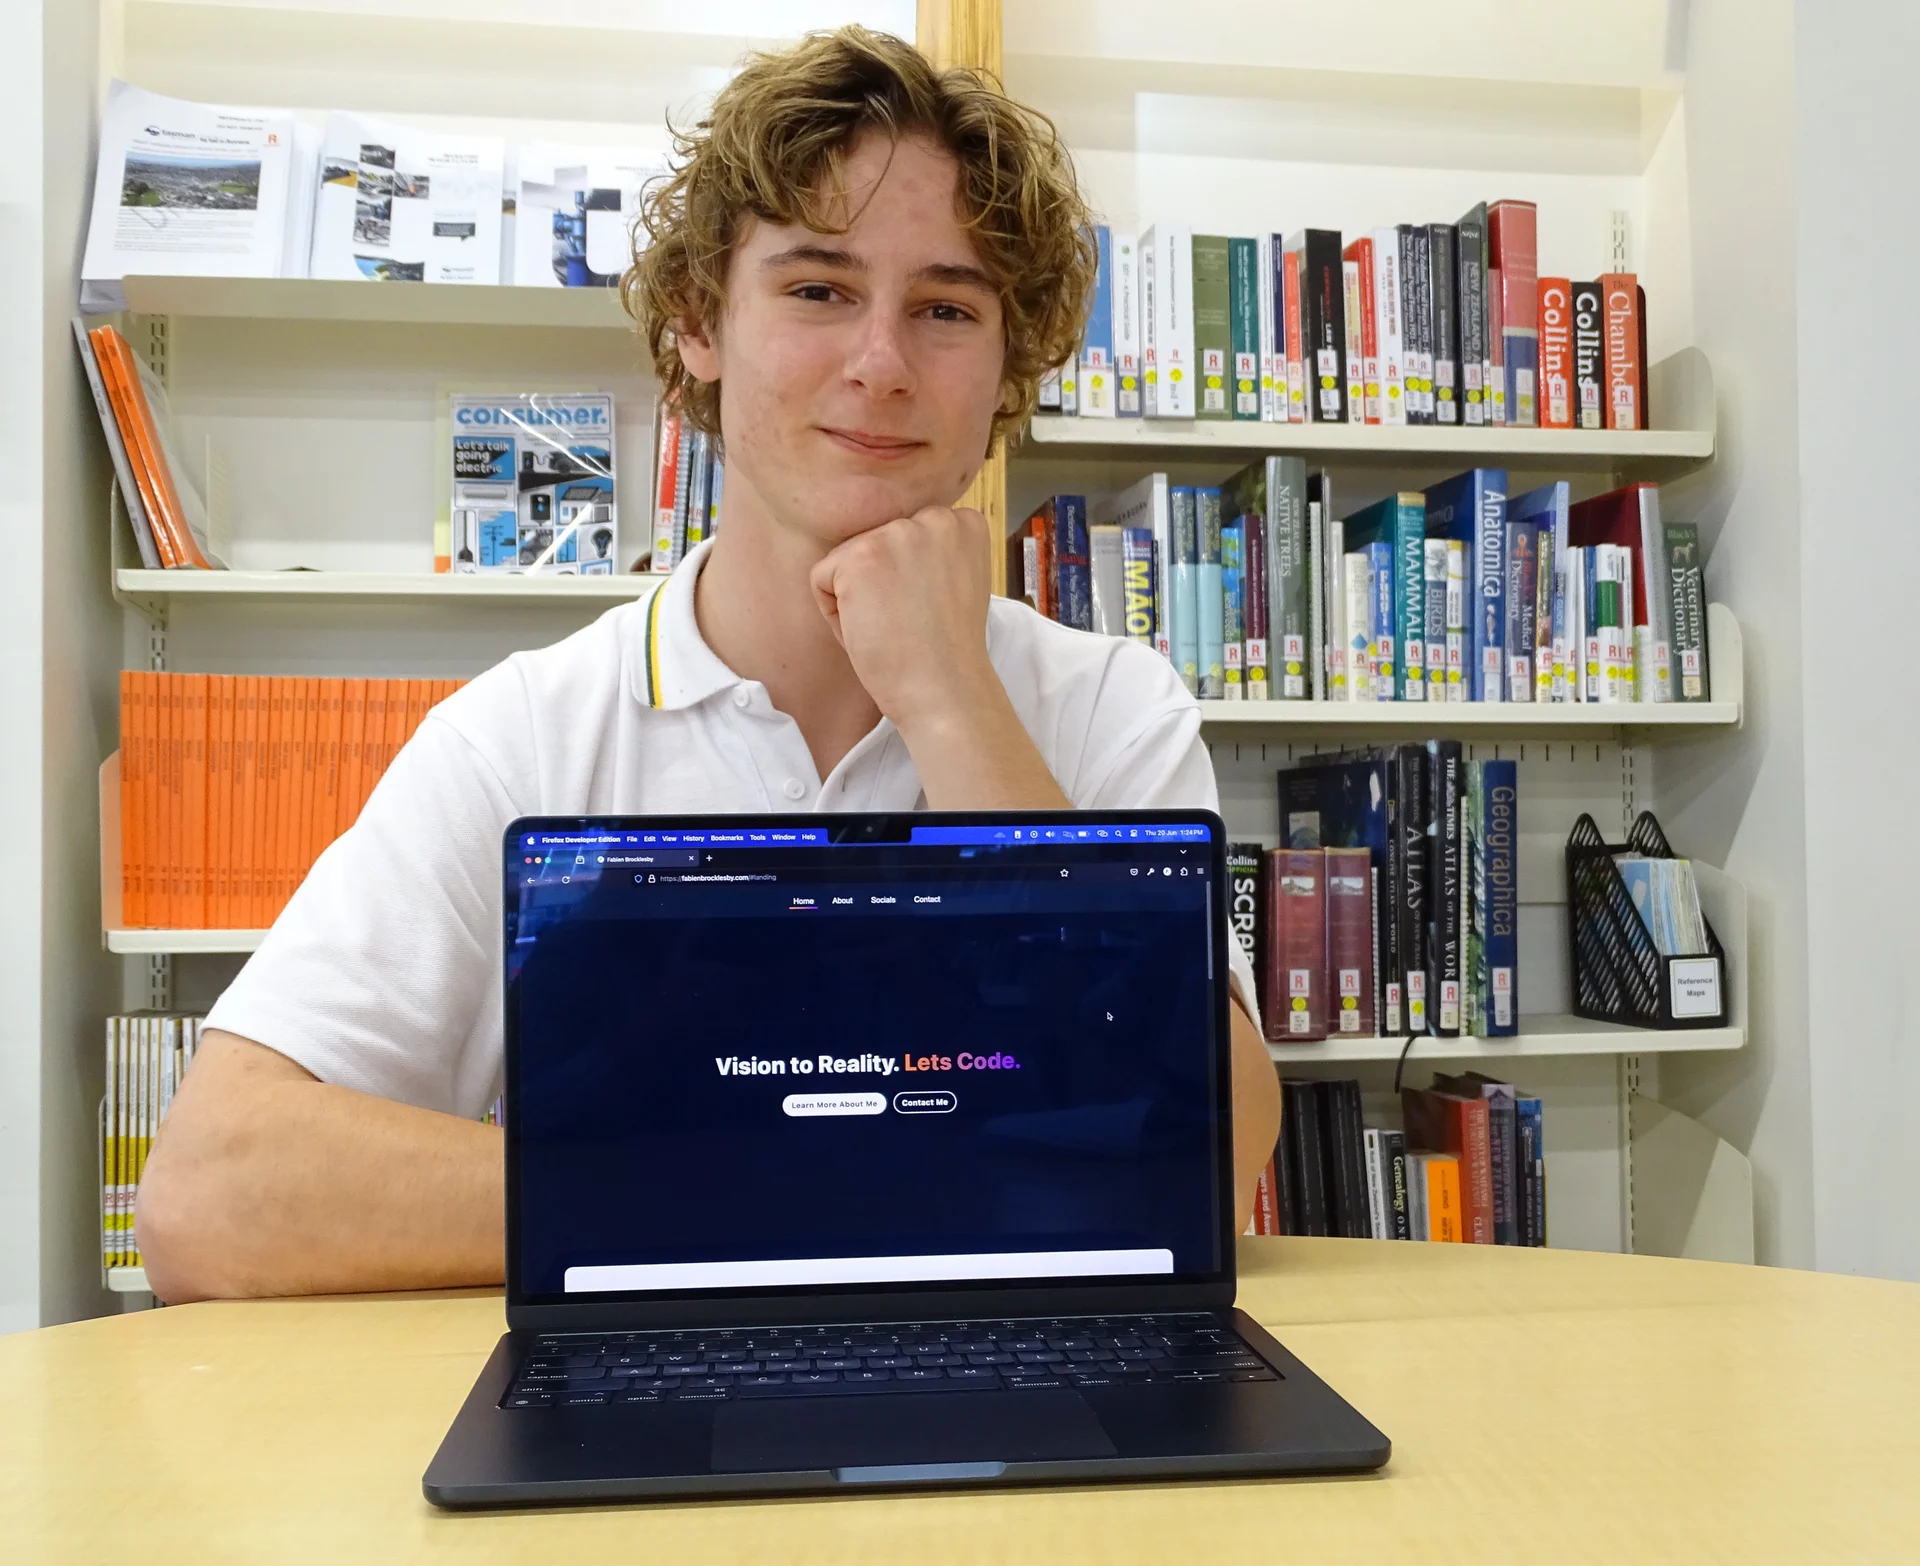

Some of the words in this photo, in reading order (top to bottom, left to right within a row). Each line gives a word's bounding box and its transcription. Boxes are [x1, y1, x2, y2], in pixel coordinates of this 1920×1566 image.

[1470, 262, 1480, 292] NEW
[1471, 294, 1481, 350] ZEALAND
[1325, 323, 1333, 343] LAW
[1544, 289, 1568, 383] Collins
[1576, 292, 1599, 388] Collins
[1093, 353, 1100, 365] R
[1147, 349, 1155, 361] R
[1173, 350, 1178, 359] R
[1124, 355, 1132, 367] R
[1210, 355, 1218, 367] R
[1242, 358, 1250, 370] R
[1324, 357, 1329, 366] R
[1555, 384, 1562, 395] R
[1586, 388, 1593, 400] R
[1620, 390, 1628, 402] R
[456, 407, 607, 425] consumer.
[456, 439, 484, 450] Let's
[486, 440, 510, 451] talk
[456, 451, 490, 463] going
[456, 463, 503, 473] electric
[1279, 485, 1291, 535] NATIVE
[1067, 505, 1076, 545] Dictionary
[1484, 490, 1506, 598] Anatomica
[1280, 537, 1291, 578] TREES
[1069, 573, 1078, 589] New
[1406, 536, 1423, 642] MAMMAL
[1511, 560, 1522, 621] Dictionary
[1071, 591, 1079, 625] Zealand
[1430, 589, 1443, 636] BIRDS
[1671, 568, 1688, 657] Dictionary
[1686, 567, 1700, 651] Veterinary
[1522, 605, 1533, 650] Medical
[1252, 644, 1260, 656] R
[1290, 640, 1297, 651] R
[1382, 640, 1389, 652] R
[1411, 645, 1419, 657] R
[1590, 642, 1598, 654] R
[1229, 648, 1238, 660] R
[1357, 653, 1365, 664] R
[1433, 649, 1440, 661] R
[1687, 655, 1694, 666] R
[1446, 757, 1456, 780] THE
[1446, 807, 1456, 840] TIMES
[542, 836, 564, 844] Firefox
[565, 836, 597, 844] Developer
[683, 835, 705, 843] History
[802, 833, 816, 841] Help
[1226, 855, 1258, 866] Collins
[1487, 786, 1515, 936] Geographica
[1407, 826, 1424, 909] ATLAS
[1445, 844, 1456, 896] ATLAS
[660, 874, 777, 882] https://fabienbrocklesby.com/#landing
[793, 897, 815, 905] Home
[870, 896, 897, 904] Socials
[913, 895, 941, 903] Contact
[1445, 902, 1454, 912] OF
[1295, 975, 1303, 988] R
[1345, 975, 1354, 987] R
[1498, 973, 1506, 985] R
[1677, 977, 1713, 986] Reference
[1447, 986, 1455, 1000] R
[715, 1055, 786, 1076] Vision
[790, 1056, 813, 1074] to
[818, 1054, 900, 1076] Reality.
[904, 1053, 952, 1072] Lets
[957, 1051, 1021, 1070] Code.
[817, 1101, 837, 1109] More
[865, 1100, 878, 1108] Me
[901, 1099, 934, 1107] Contact
[935, 1098, 948, 1106] Me
[1393, 1156, 1406, 1213] Genealogy
[1261, 1194, 1270, 1212] and
